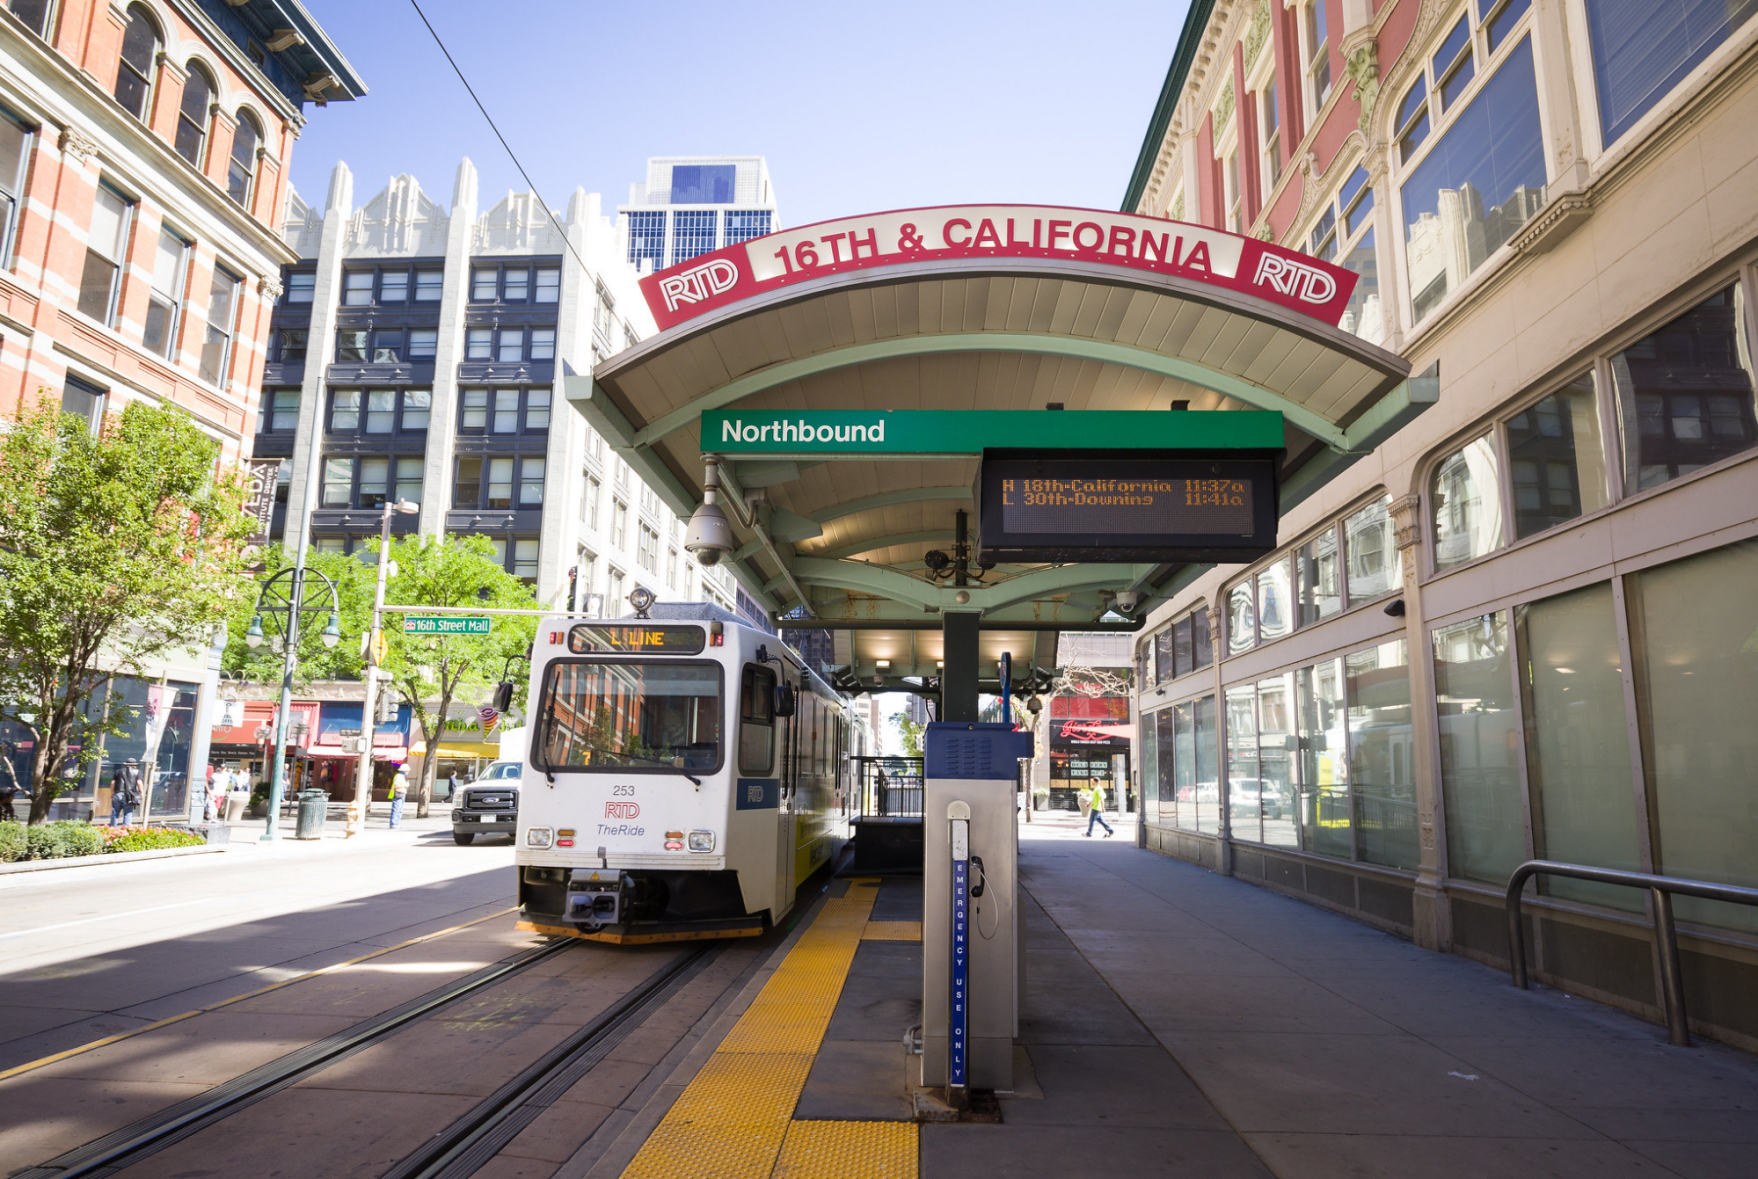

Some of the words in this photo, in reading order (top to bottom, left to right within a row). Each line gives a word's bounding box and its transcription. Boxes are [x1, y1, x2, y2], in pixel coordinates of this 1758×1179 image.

[774, 227, 879, 275] 16TH
[897, 222, 927, 253] &
[943, 217, 1213, 274] CALIFORNIA
[658, 258, 739, 313] RTD
[1252, 251, 1337, 304] RTD
[721, 419, 885, 442] Northbound
[263, 467, 275, 494] DENVER
[1002, 479, 1014, 492] H
[1023, 479, 1173, 492] 18th-California
[1185, 479, 1245, 492] 11:37a
[1002, 492, 1014, 505] L
[1023, 492, 1154, 505] 30th-Downing
[1185, 492, 1244, 505] 11:41a
[416, 620, 436, 631] 16th
[437, 620, 467, 632] Street
[468, 620, 489, 632] Mall
[611, 631, 621, 645] L
[629, 631, 665, 646] LINE
[612, 785, 635, 796] 253
[748, 785, 764, 803] RTD
[605, 801, 641, 820] RTD
[597, 823, 645, 836] TheRide
[956, 864, 964, 966] EMERGENCY
